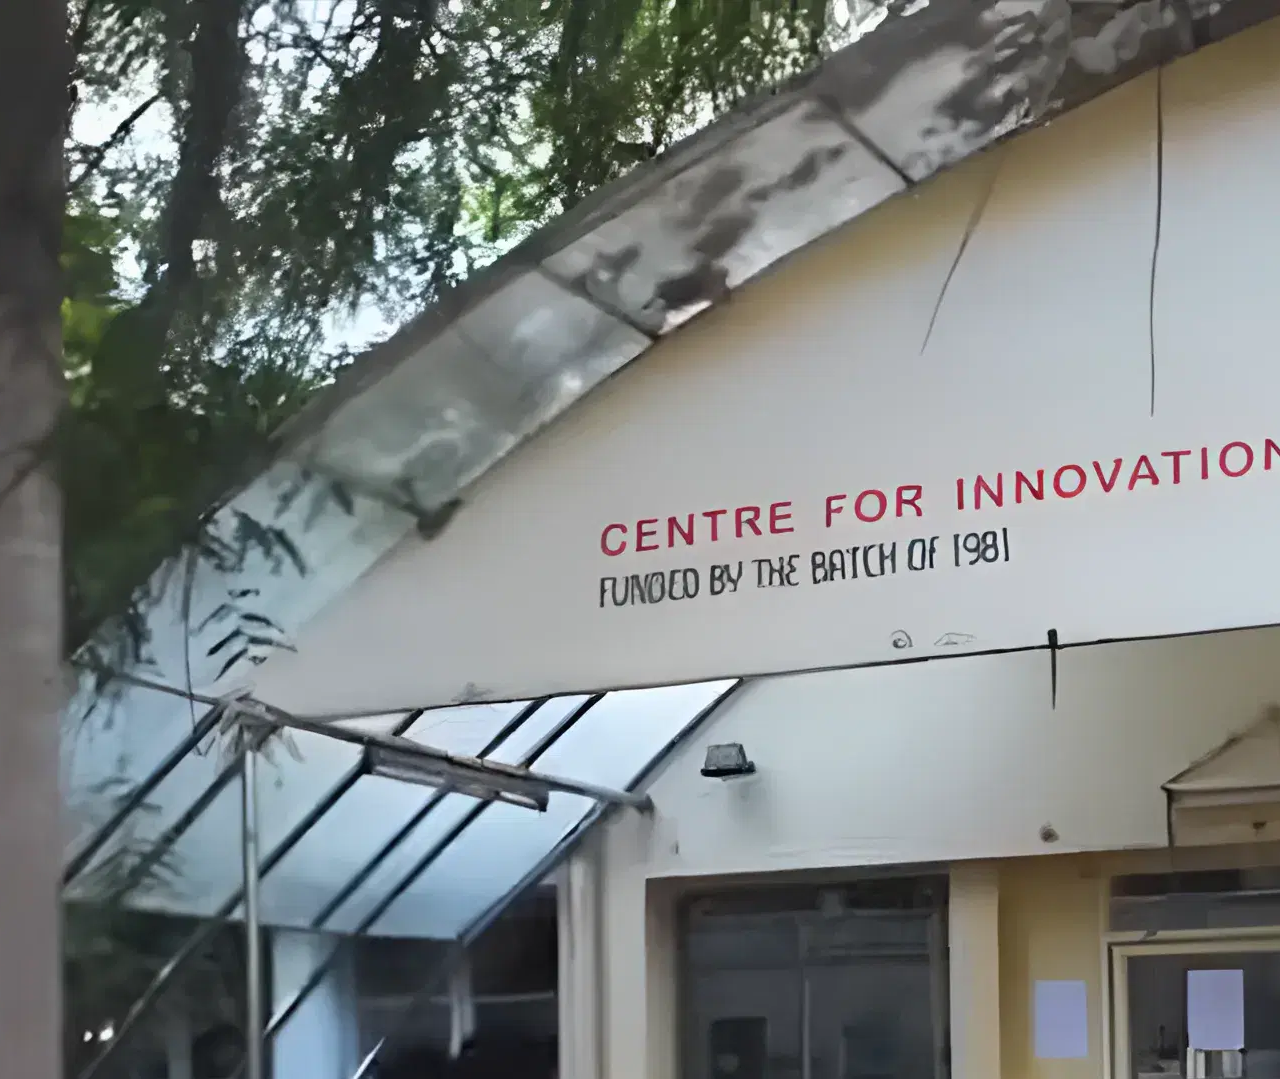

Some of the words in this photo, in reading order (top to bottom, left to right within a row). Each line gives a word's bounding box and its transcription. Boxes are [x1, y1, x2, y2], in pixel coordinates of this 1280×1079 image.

[600, 501, 795, 557] CENTRE
[824, 484, 924, 528] FOR
[599, 566, 700, 608] FUNDED
[709, 560, 744, 597] BY
[751, 553, 801, 589] THE
[810, 541, 898, 585] BATCH
[906, 535, 941, 572] OF
[953, 527, 1011, 568] 1981
